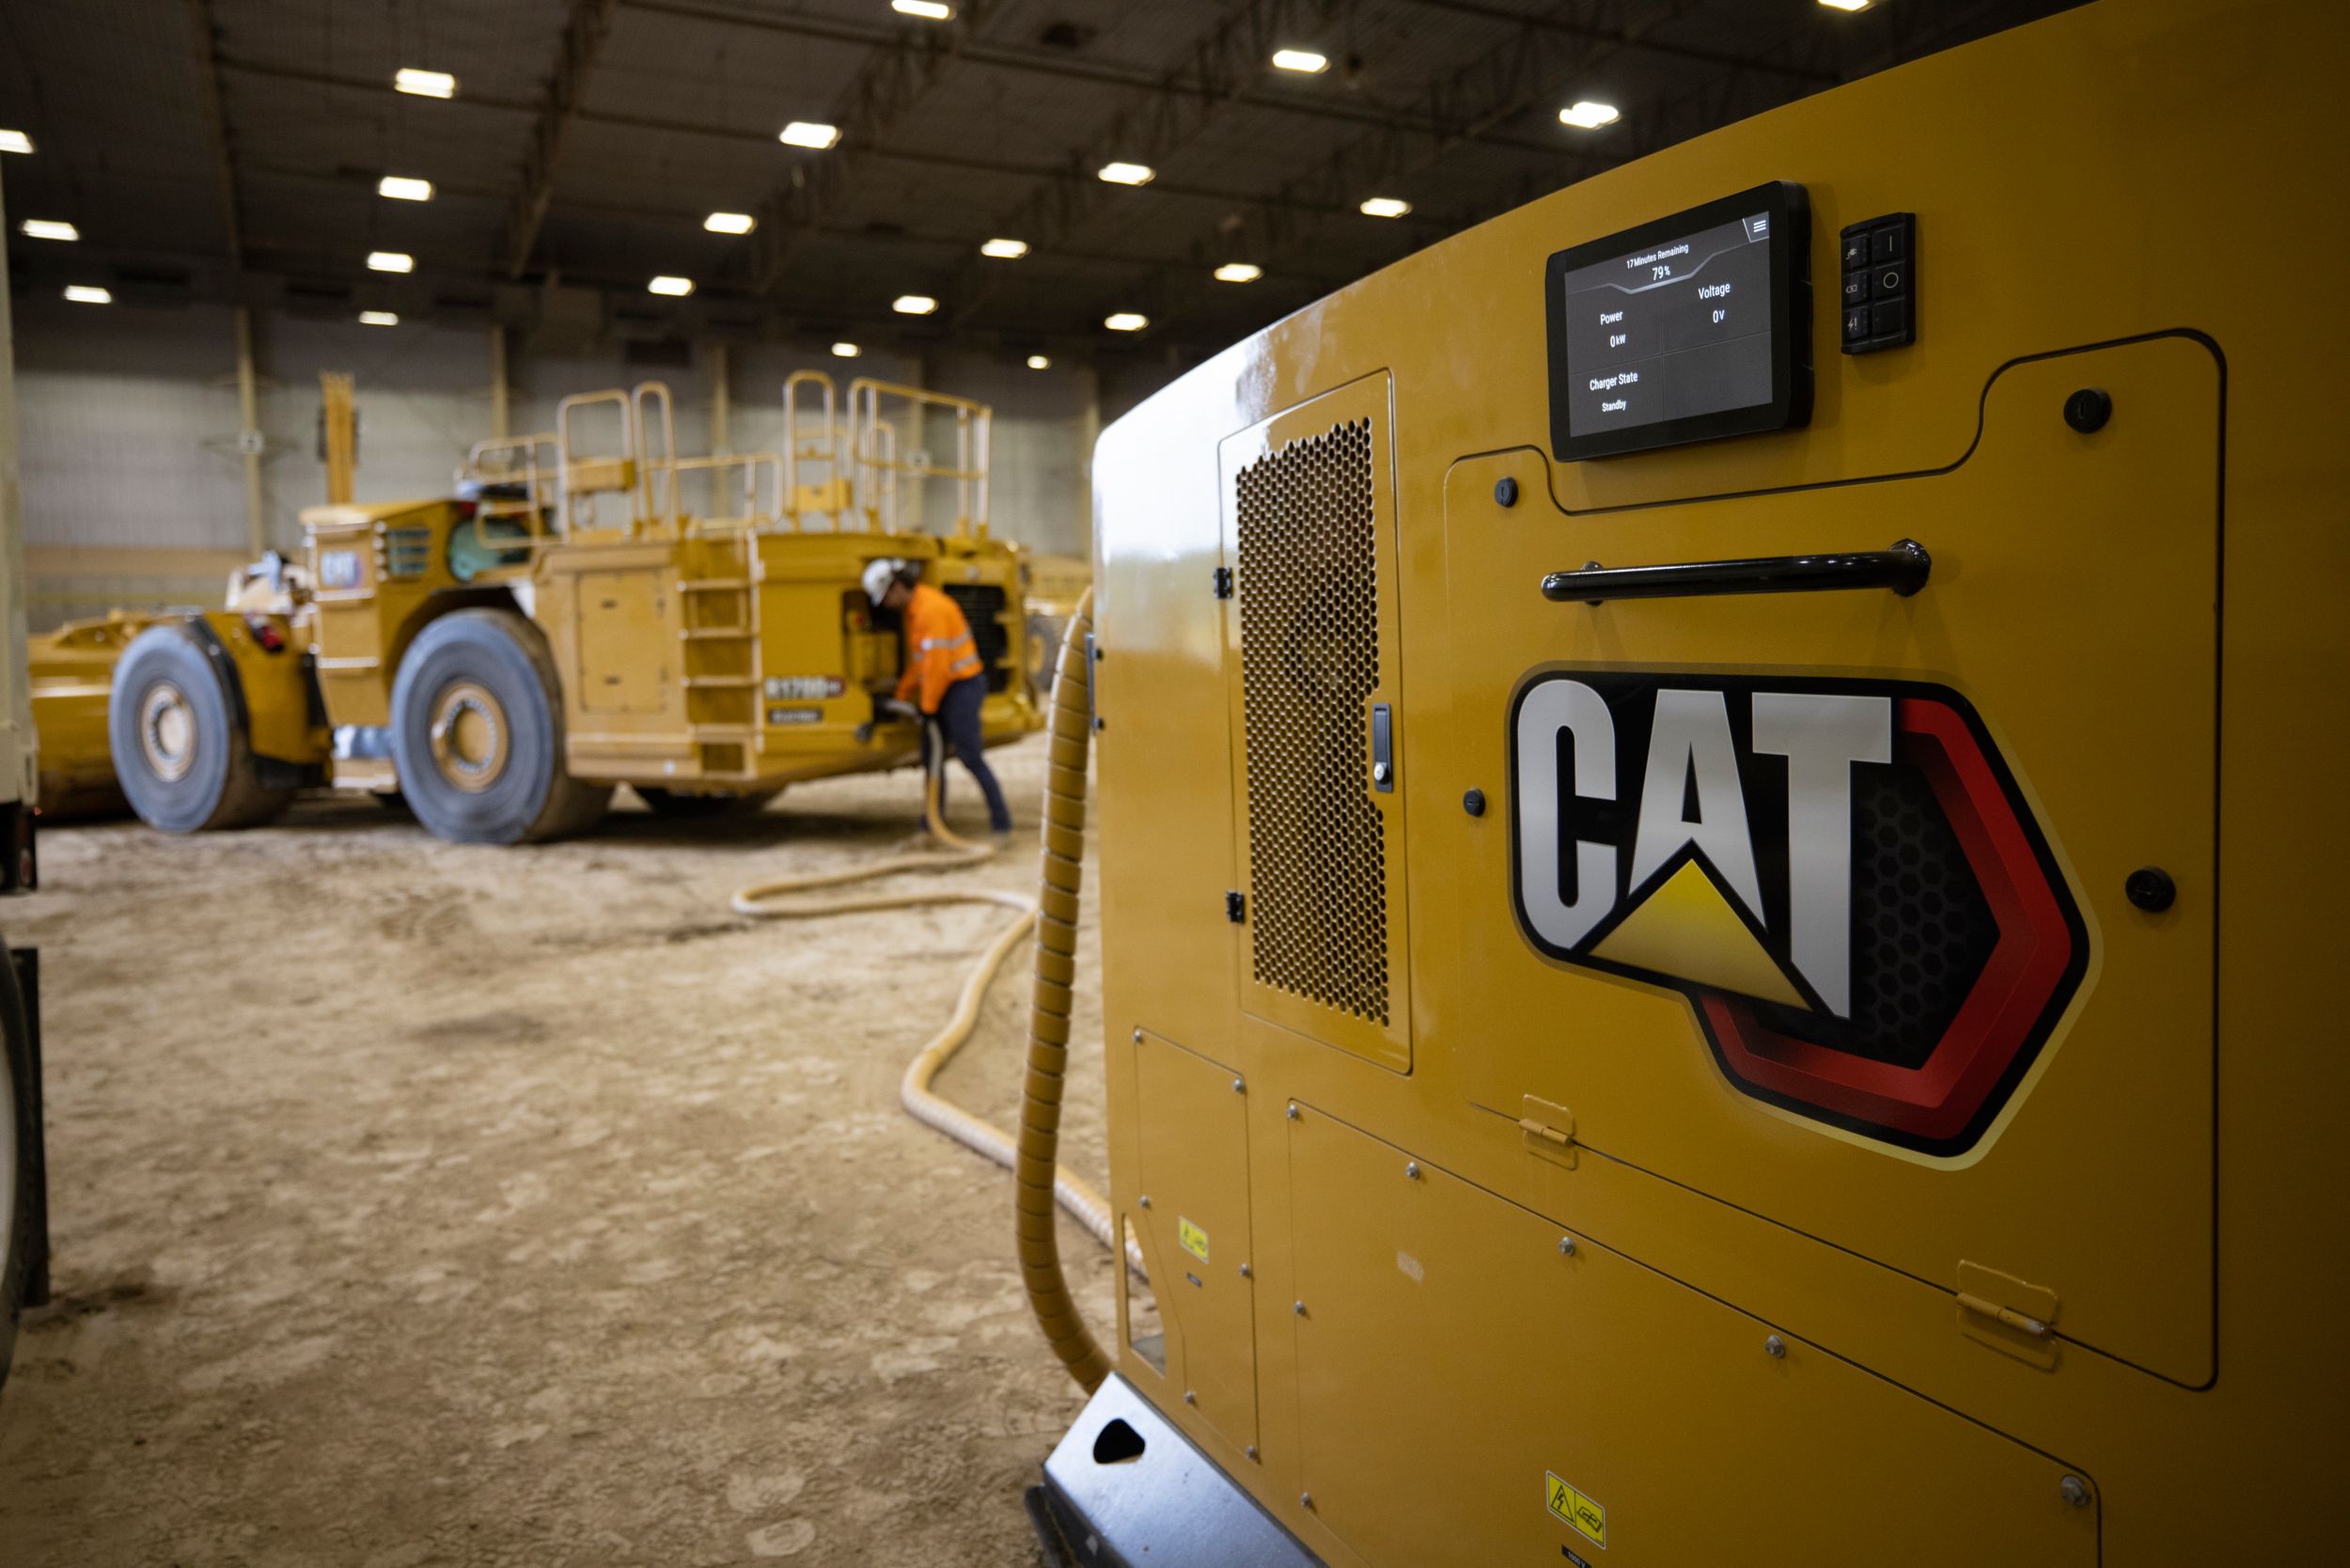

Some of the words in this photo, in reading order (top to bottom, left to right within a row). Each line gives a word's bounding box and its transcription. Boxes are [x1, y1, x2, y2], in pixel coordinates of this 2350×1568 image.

[1634, 253, 1657, 267] Minutes
[1657, 243, 1689, 259] Remaining
[1698, 283, 1731, 300] Voltage
[1600, 311, 1623, 325] Power
[1590, 377, 1618, 391] Charger
[1619, 372, 1638, 385] State
[1602, 400, 1627, 412] Standby
[1517, 678, 1892, 1021] CAT
